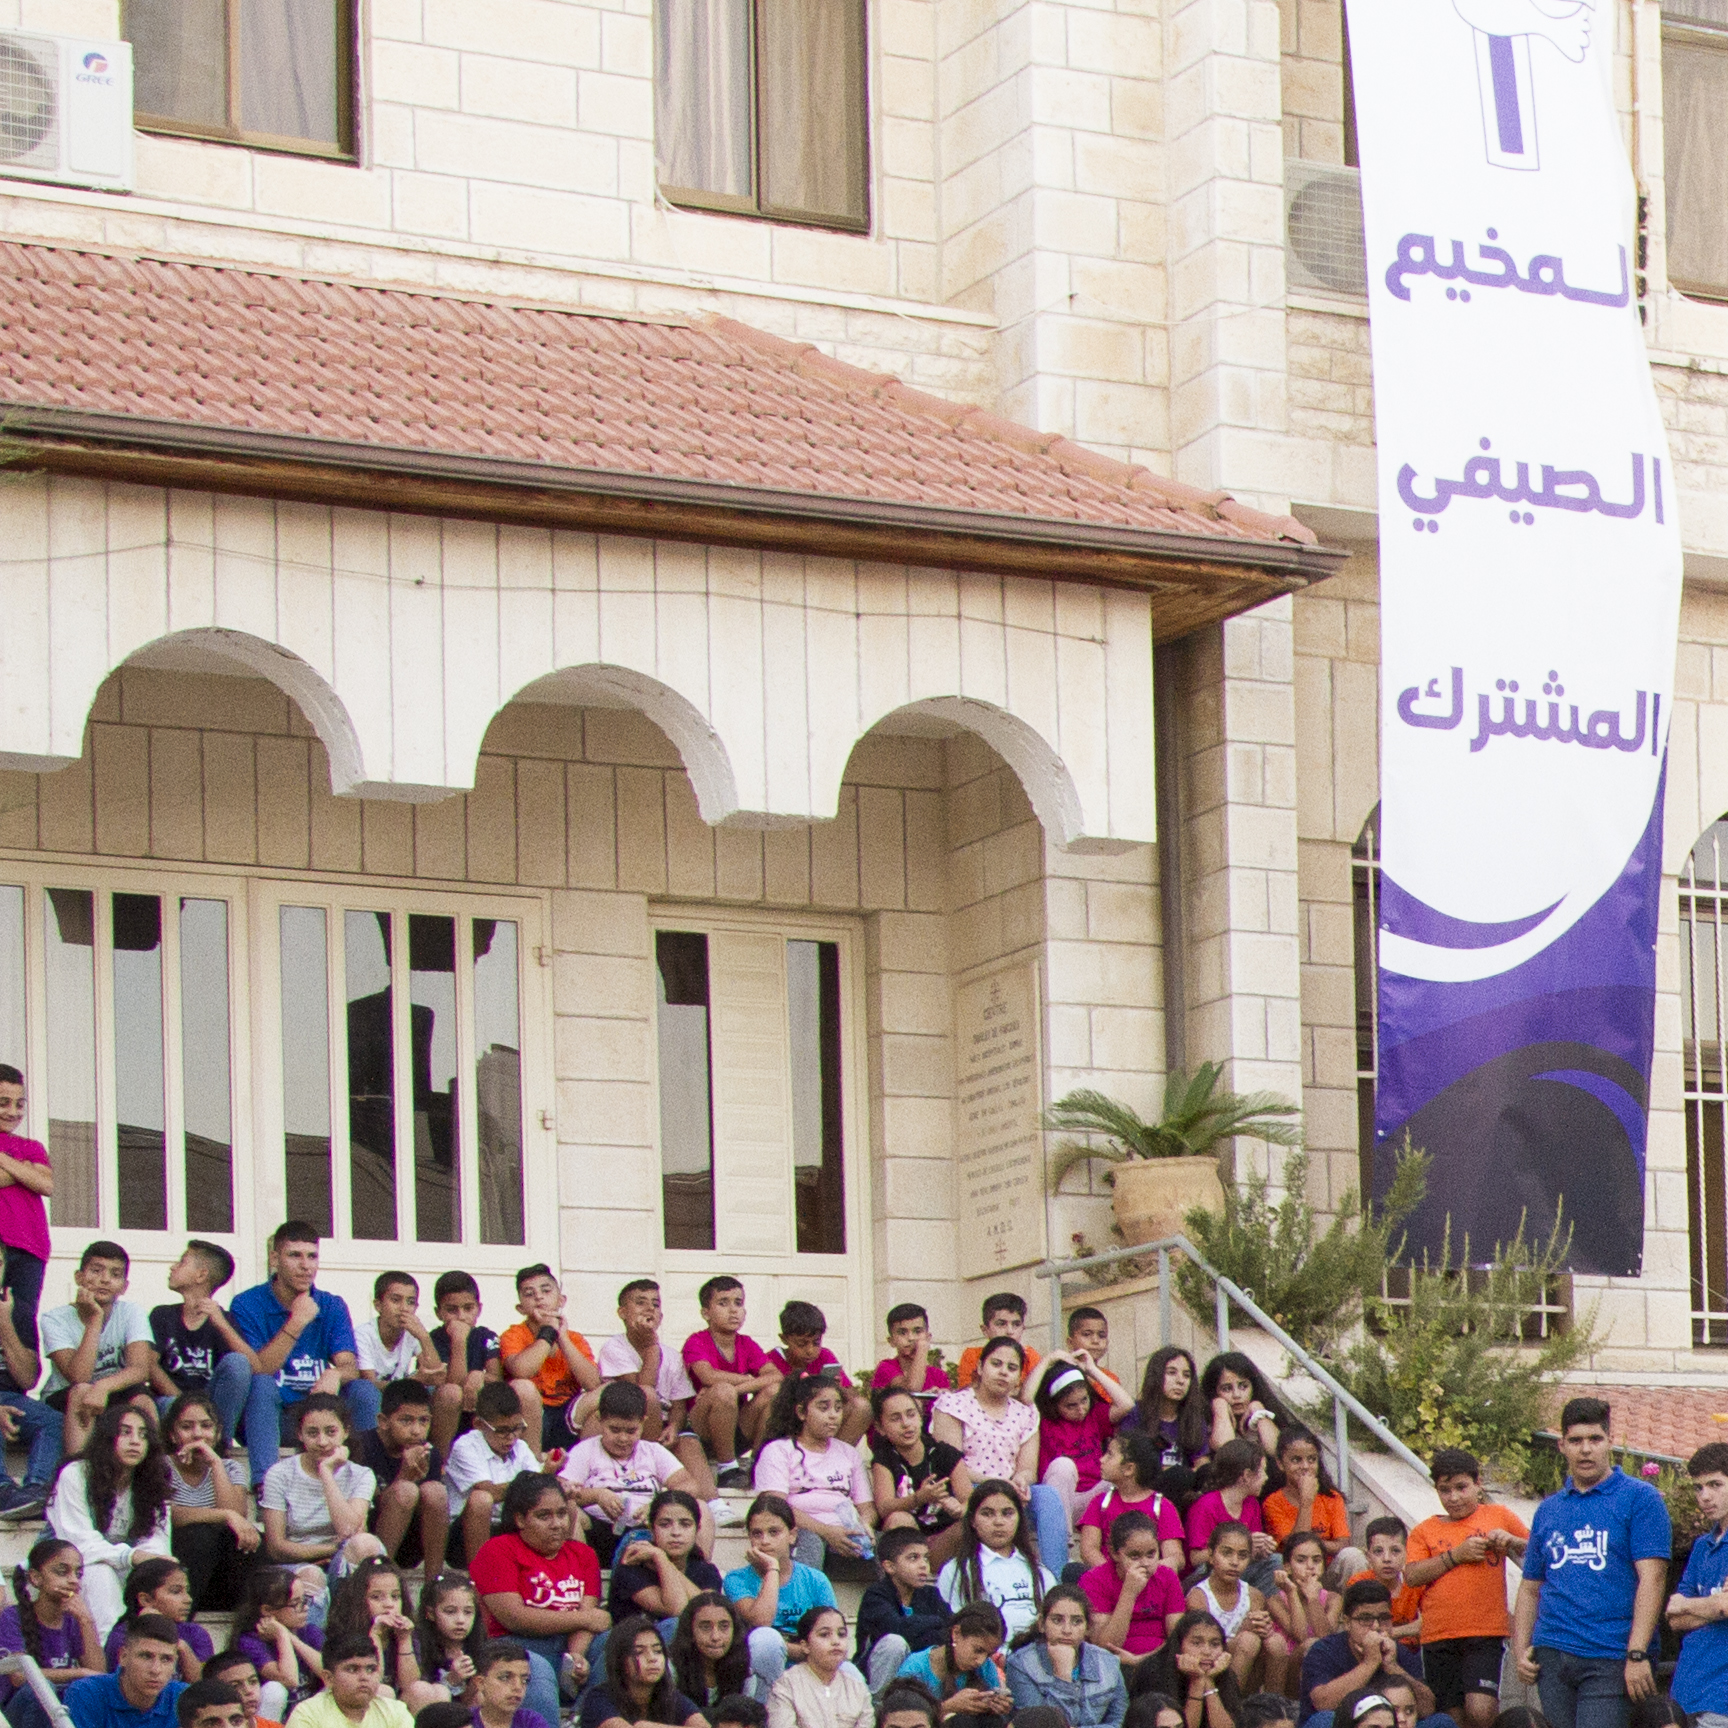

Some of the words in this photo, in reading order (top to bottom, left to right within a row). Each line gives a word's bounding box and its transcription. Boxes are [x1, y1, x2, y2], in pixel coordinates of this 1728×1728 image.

[1384, 226, 1630, 309] لمخيم
[1396, 436, 1666, 534] الصيفي
[1396, 665, 1662, 758] المشترك
